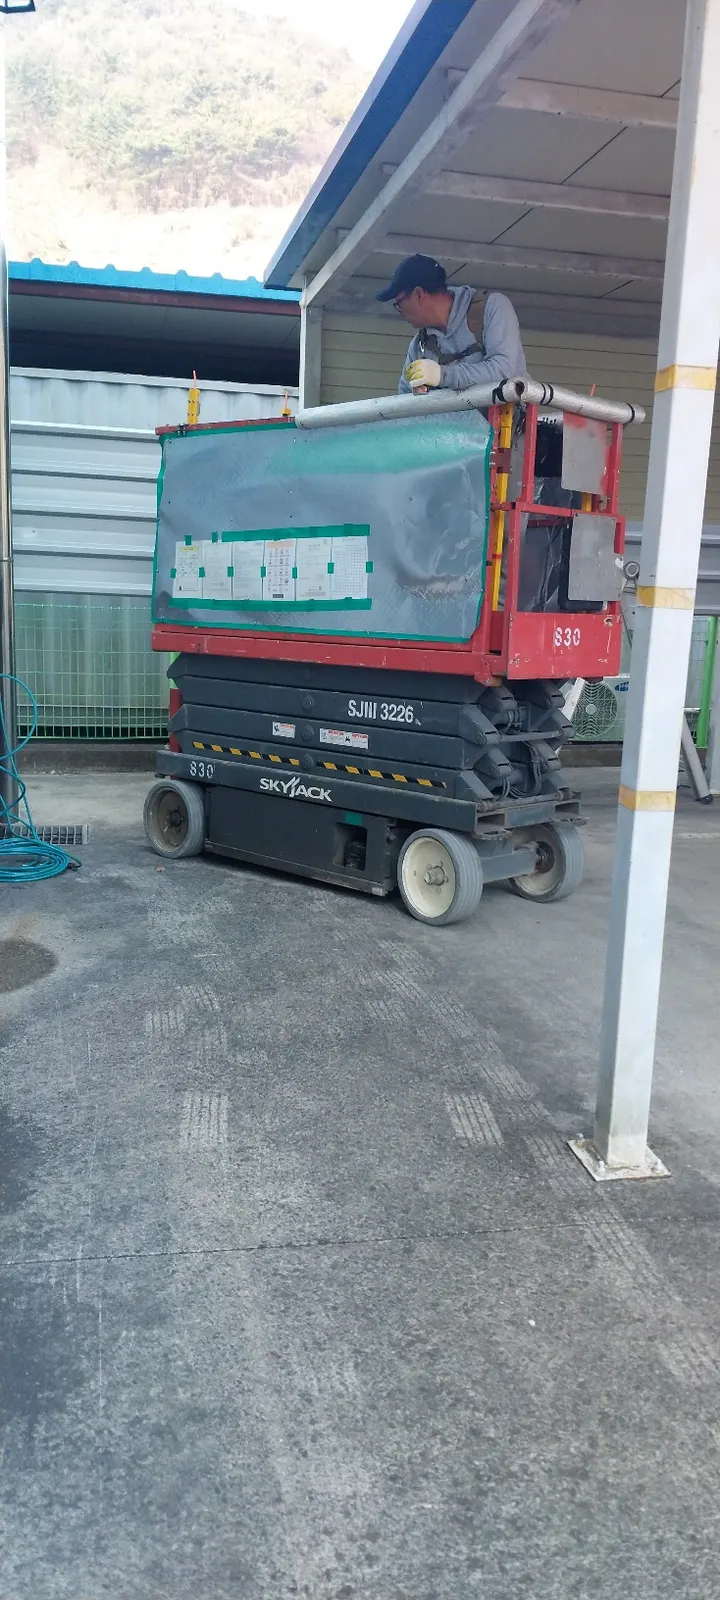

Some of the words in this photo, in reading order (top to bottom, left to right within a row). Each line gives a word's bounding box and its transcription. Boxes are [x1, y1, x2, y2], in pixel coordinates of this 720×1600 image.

[554, 626, 581, 647] 830
[347, 699, 378, 719] SJIII
[380, 702, 414, 724] 3226
[259, 776, 333, 802] SKYJACK
